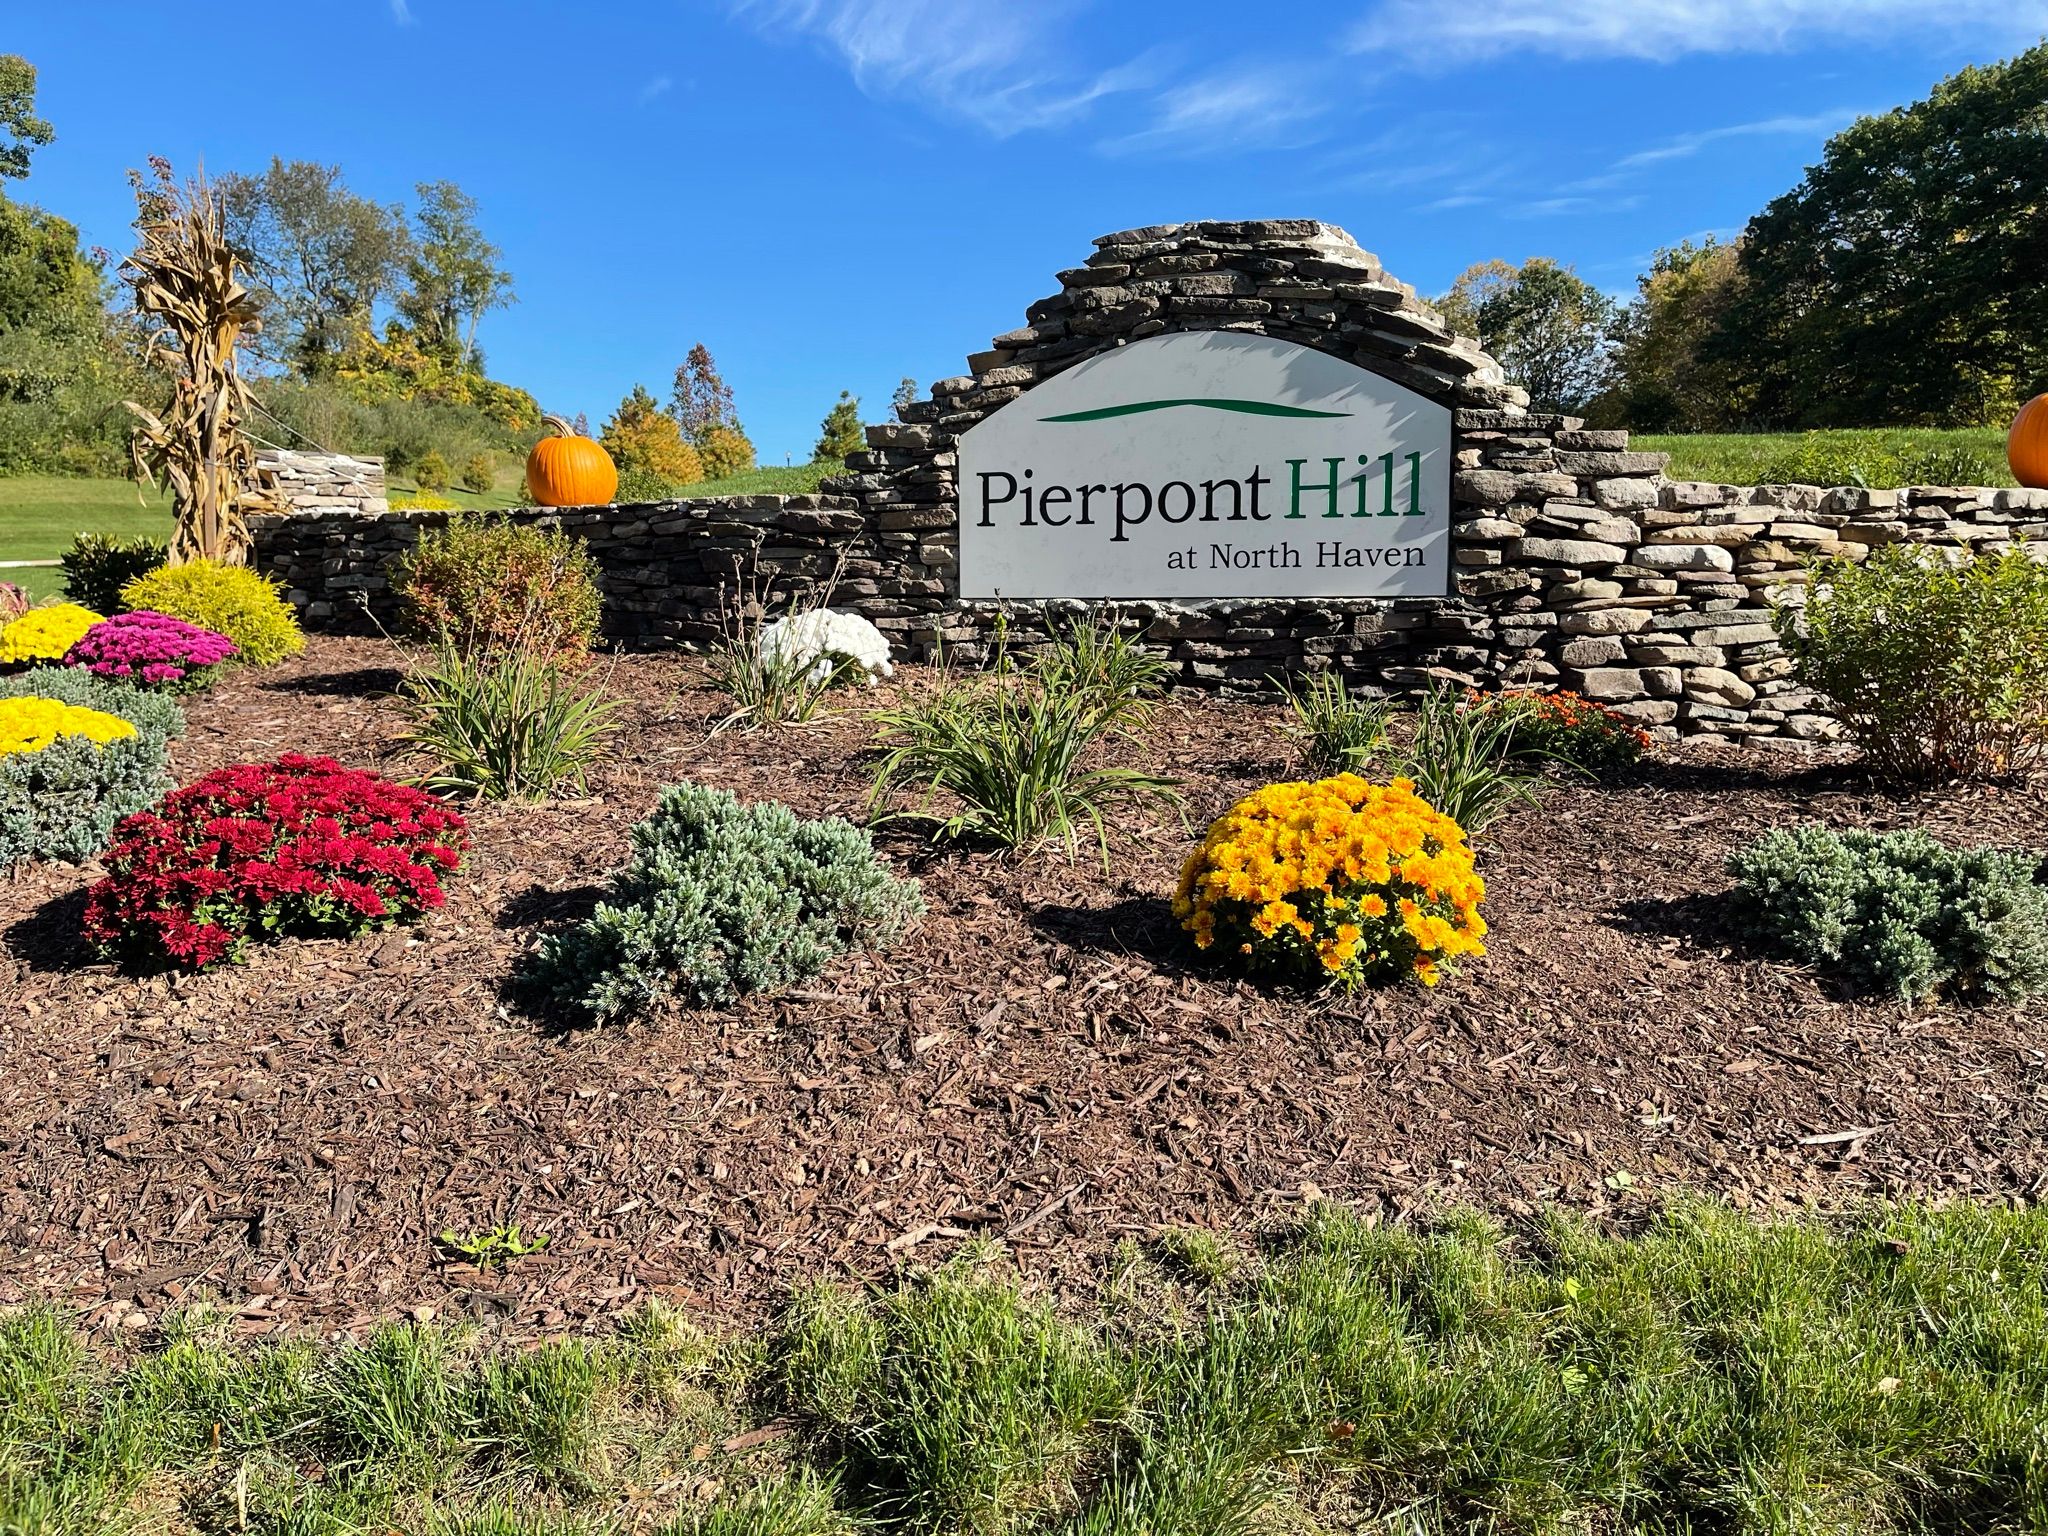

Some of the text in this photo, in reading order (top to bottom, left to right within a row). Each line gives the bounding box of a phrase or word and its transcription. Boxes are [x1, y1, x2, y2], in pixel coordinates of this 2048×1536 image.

[976, 450, 1427, 542] Pierpont Hill
[1167, 541, 1427, 570] at North Haven
